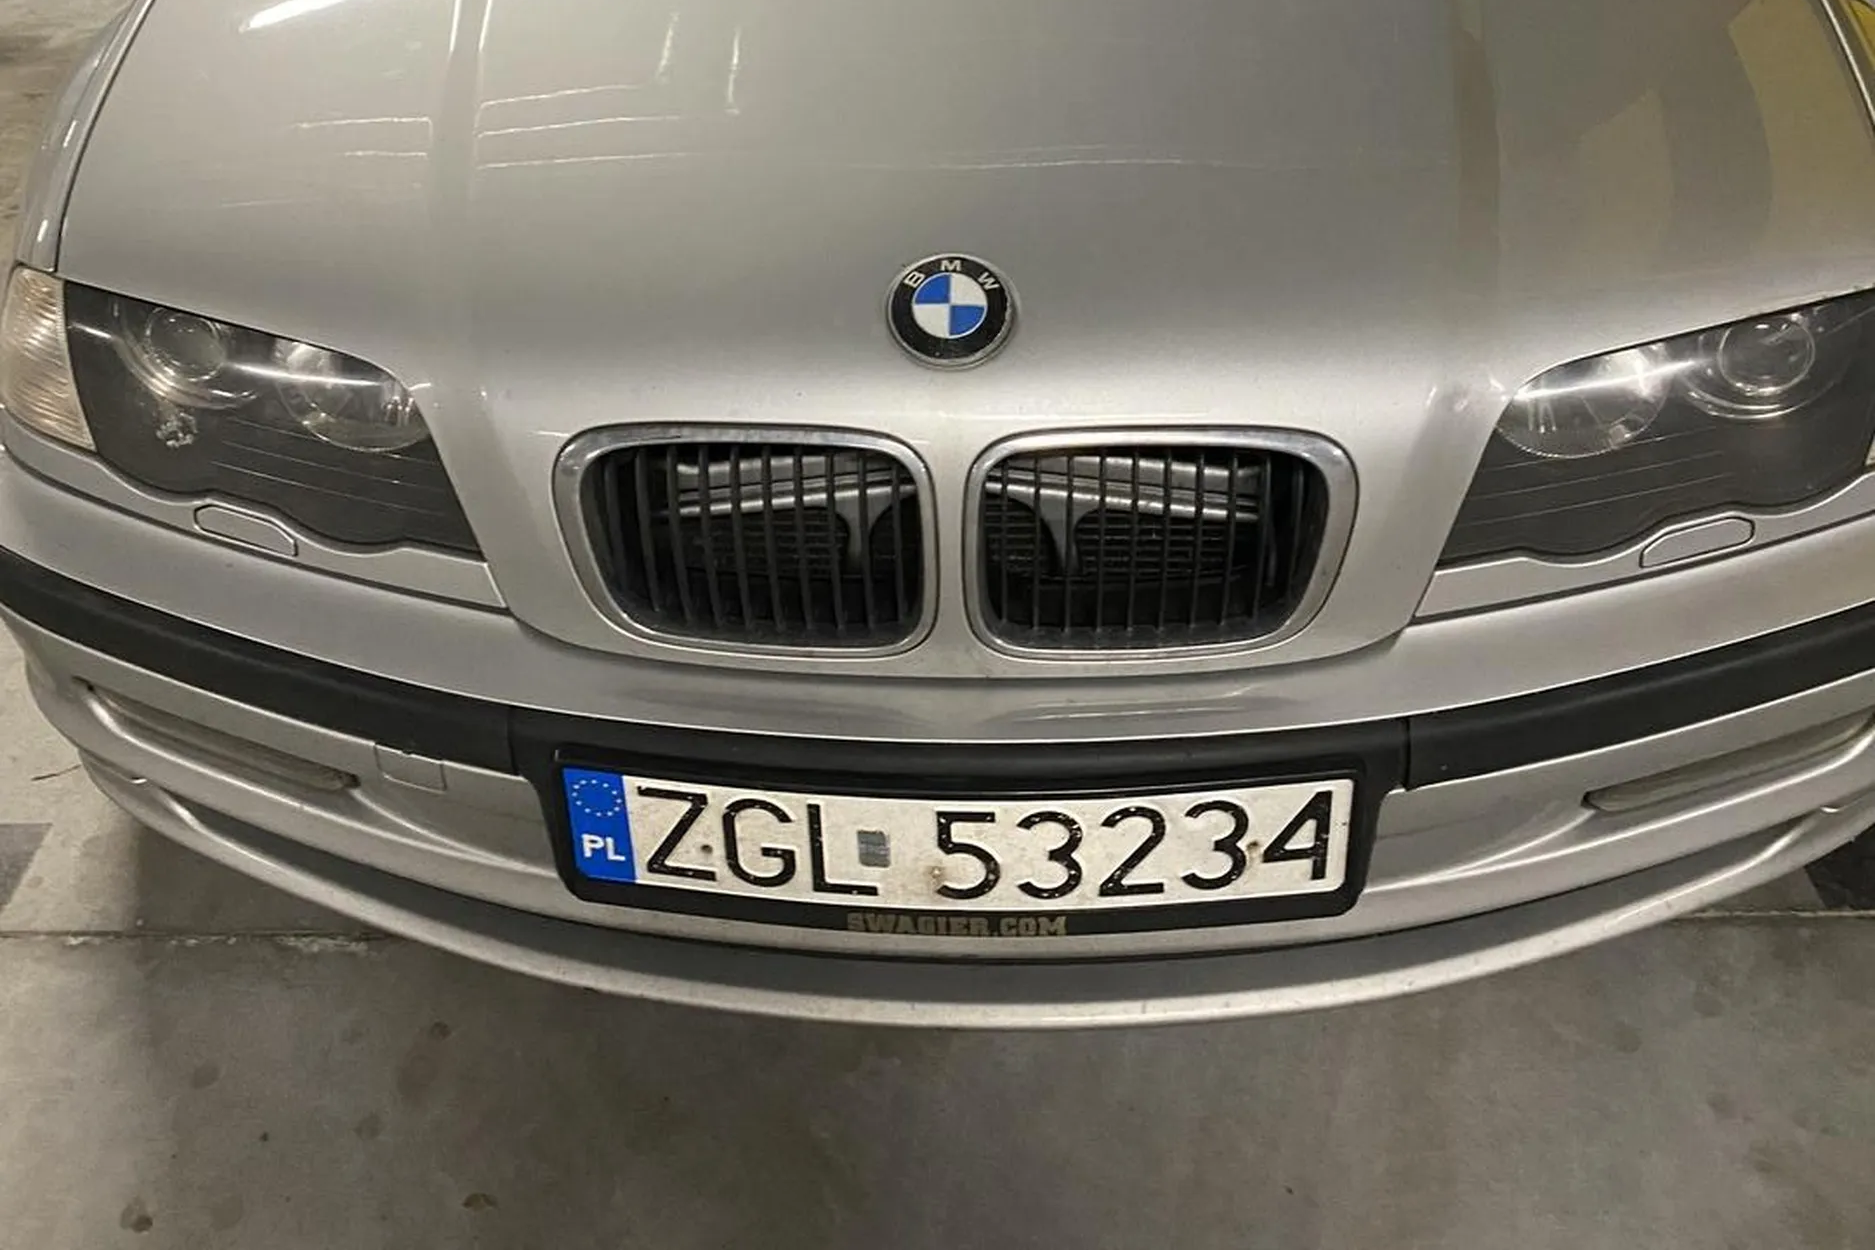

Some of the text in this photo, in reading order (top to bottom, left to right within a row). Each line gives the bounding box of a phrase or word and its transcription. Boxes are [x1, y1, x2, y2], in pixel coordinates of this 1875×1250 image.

[903, 259, 1000, 291] BMW
[581, 833, 626, 862] PL
[637, 785, 1333, 900] ZGL 53234
